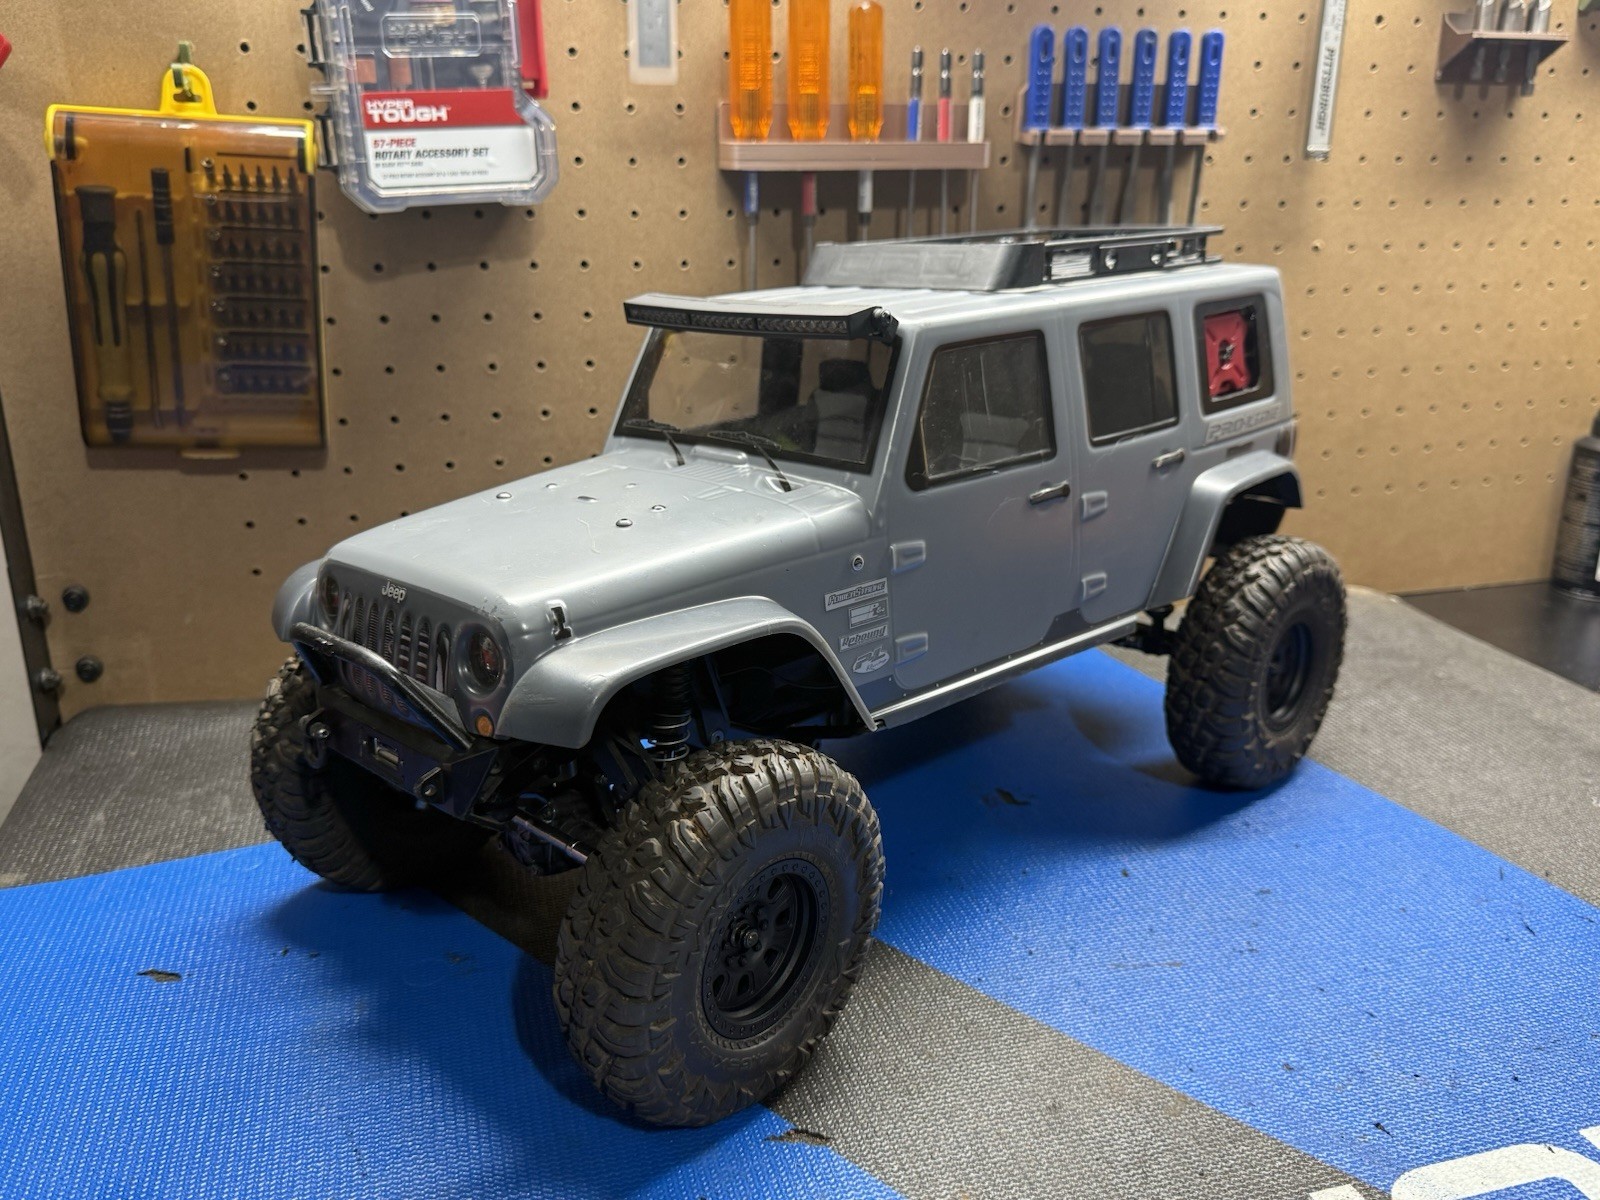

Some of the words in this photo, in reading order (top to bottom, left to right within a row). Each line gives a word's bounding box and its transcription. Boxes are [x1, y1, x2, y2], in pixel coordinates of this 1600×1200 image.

[1315, 46, 1335, 131] PITTSBURGH
[366, 99, 414, 110] HYPER
[367, 106, 448, 123] TOUGH
[373, 138, 416, 149] 57-PIECE
[375, 150, 412, 160] ROTARY
[415, 147, 469, 159] ACCESSORY
[472, 147, 489, 158] SET
[381, 580, 406, 603] Jeep
[841, 625, 887, 648] Rebound
